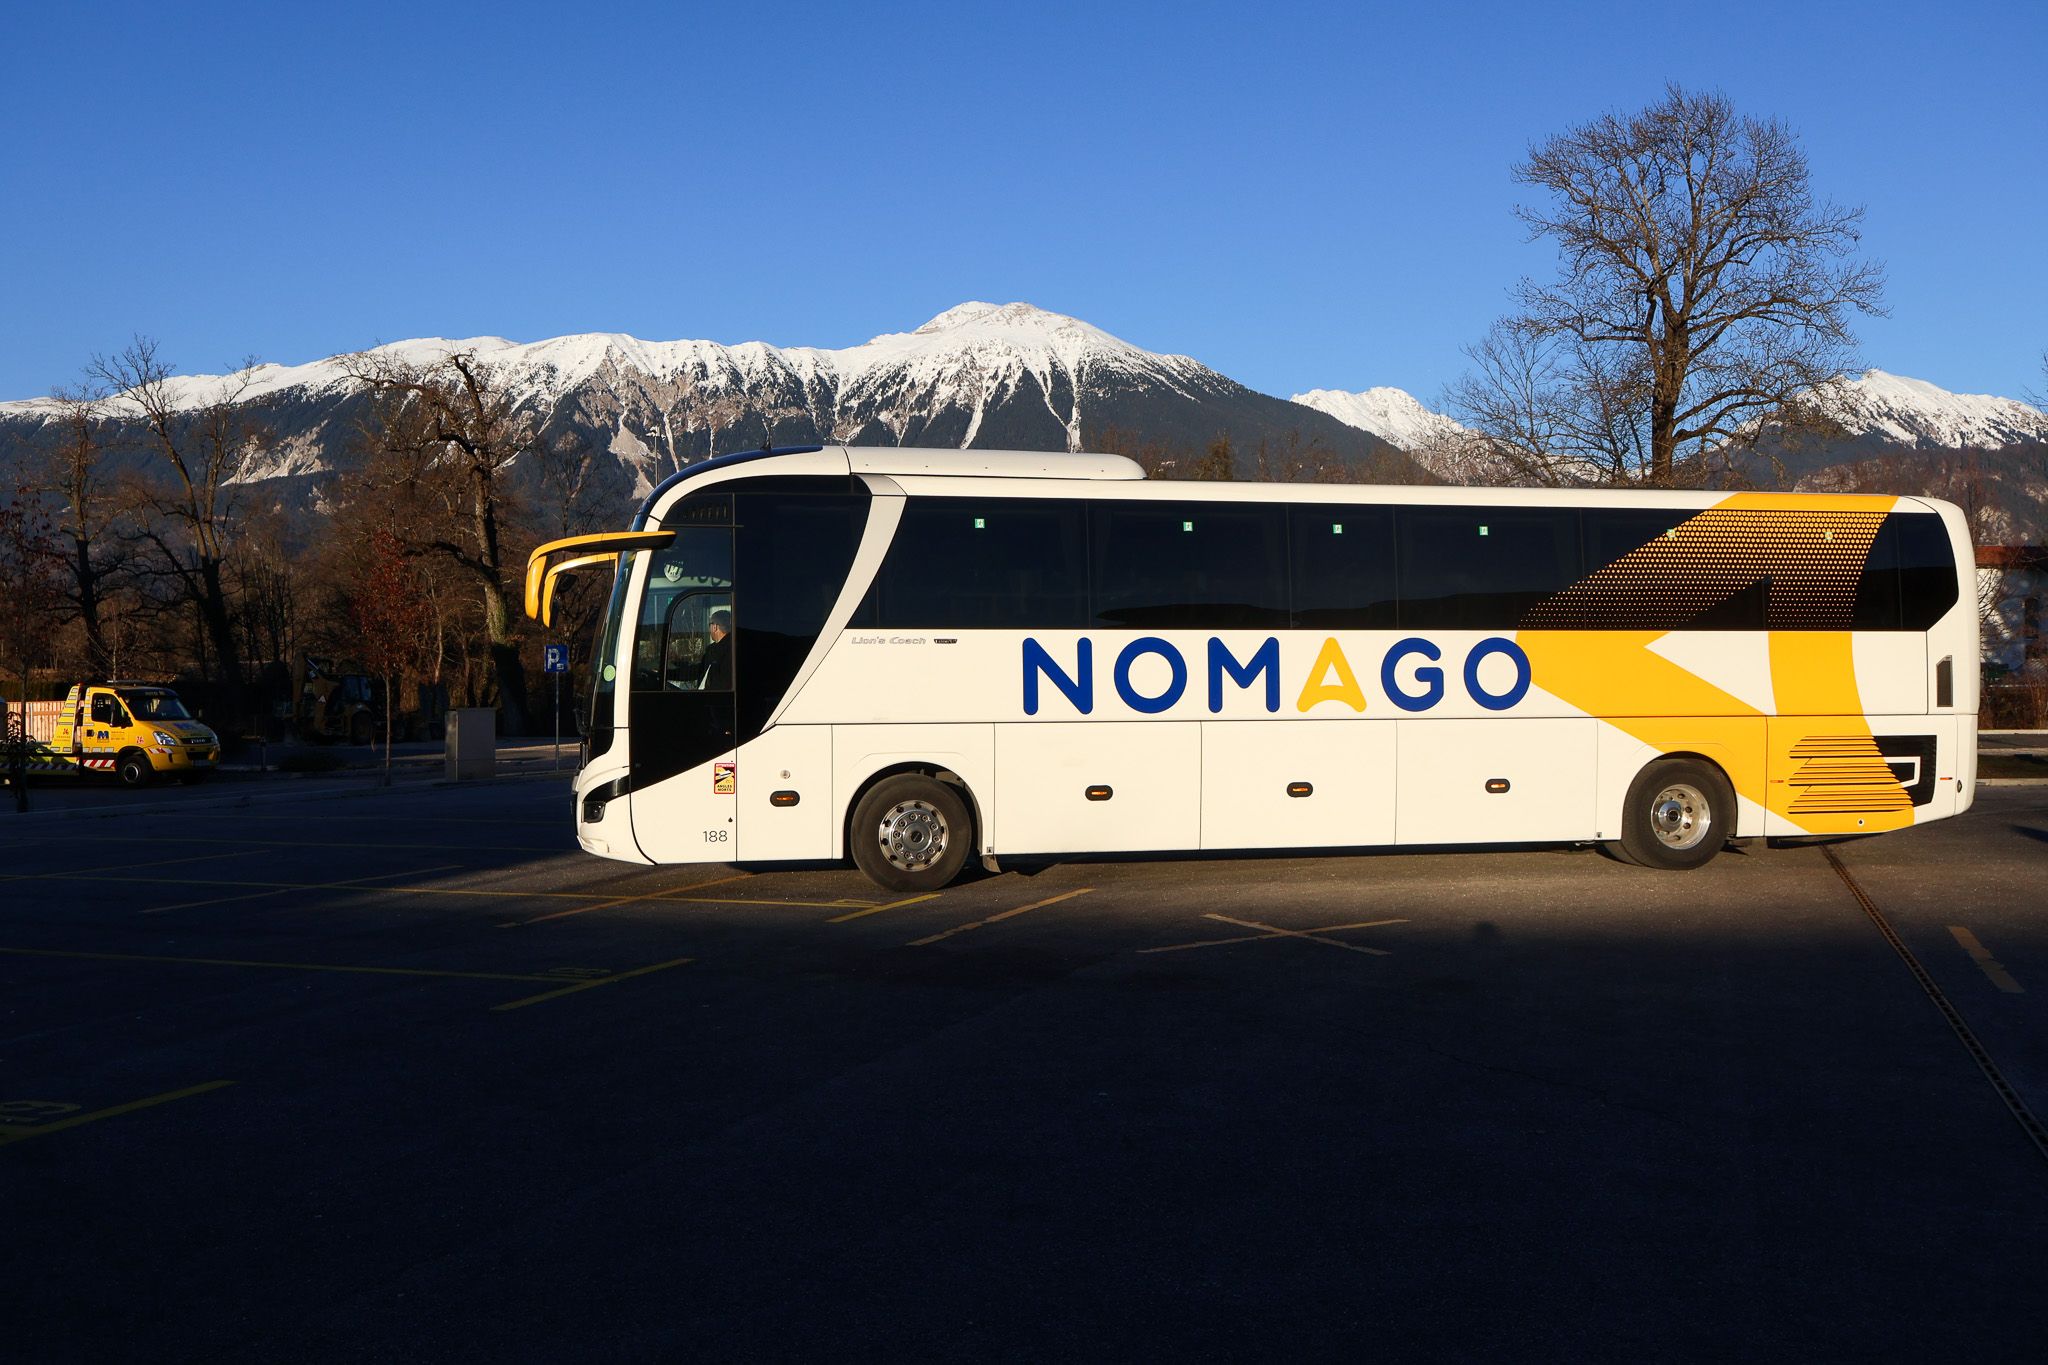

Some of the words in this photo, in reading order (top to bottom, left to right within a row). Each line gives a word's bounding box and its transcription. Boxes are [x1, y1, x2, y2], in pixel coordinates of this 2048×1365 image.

[889, 636, 927, 645] Coach
[547, 648, 560, 670] P
[1023, 637, 1532, 715] NOMAGO
[703, 830, 728, 843] 188
